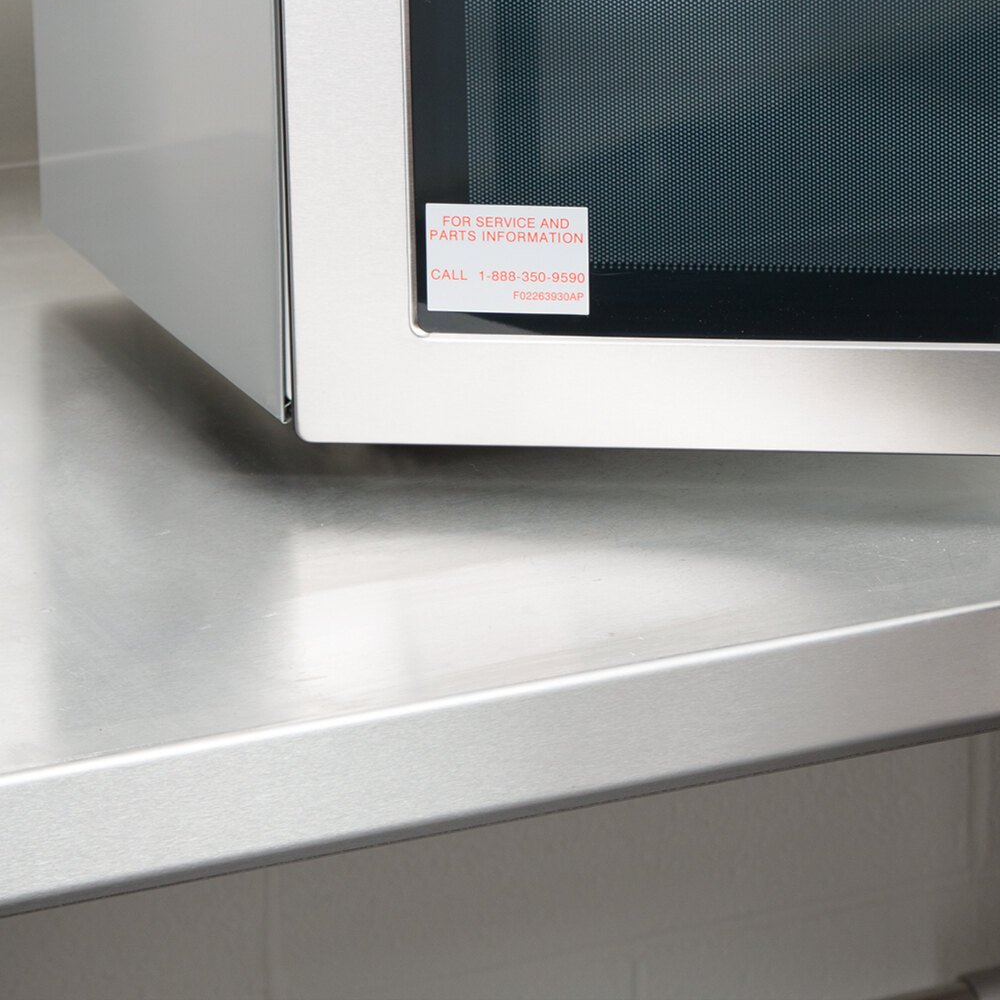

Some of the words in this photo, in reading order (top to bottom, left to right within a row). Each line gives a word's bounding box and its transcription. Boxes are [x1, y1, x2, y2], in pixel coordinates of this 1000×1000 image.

[442, 215, 471, 228] FOR
[475, 216, 535, 229] SERVICE
[540, 217, 570, 230] AND
[429, 229, 477, 242] PARTS
[481, 231, 584, 244] INFORMATION
[430, 268, 468, 281] CALL
[479, 270, 585, 284] 1-888-350-9590
[513, 290, 584, 302] F02263930AP
